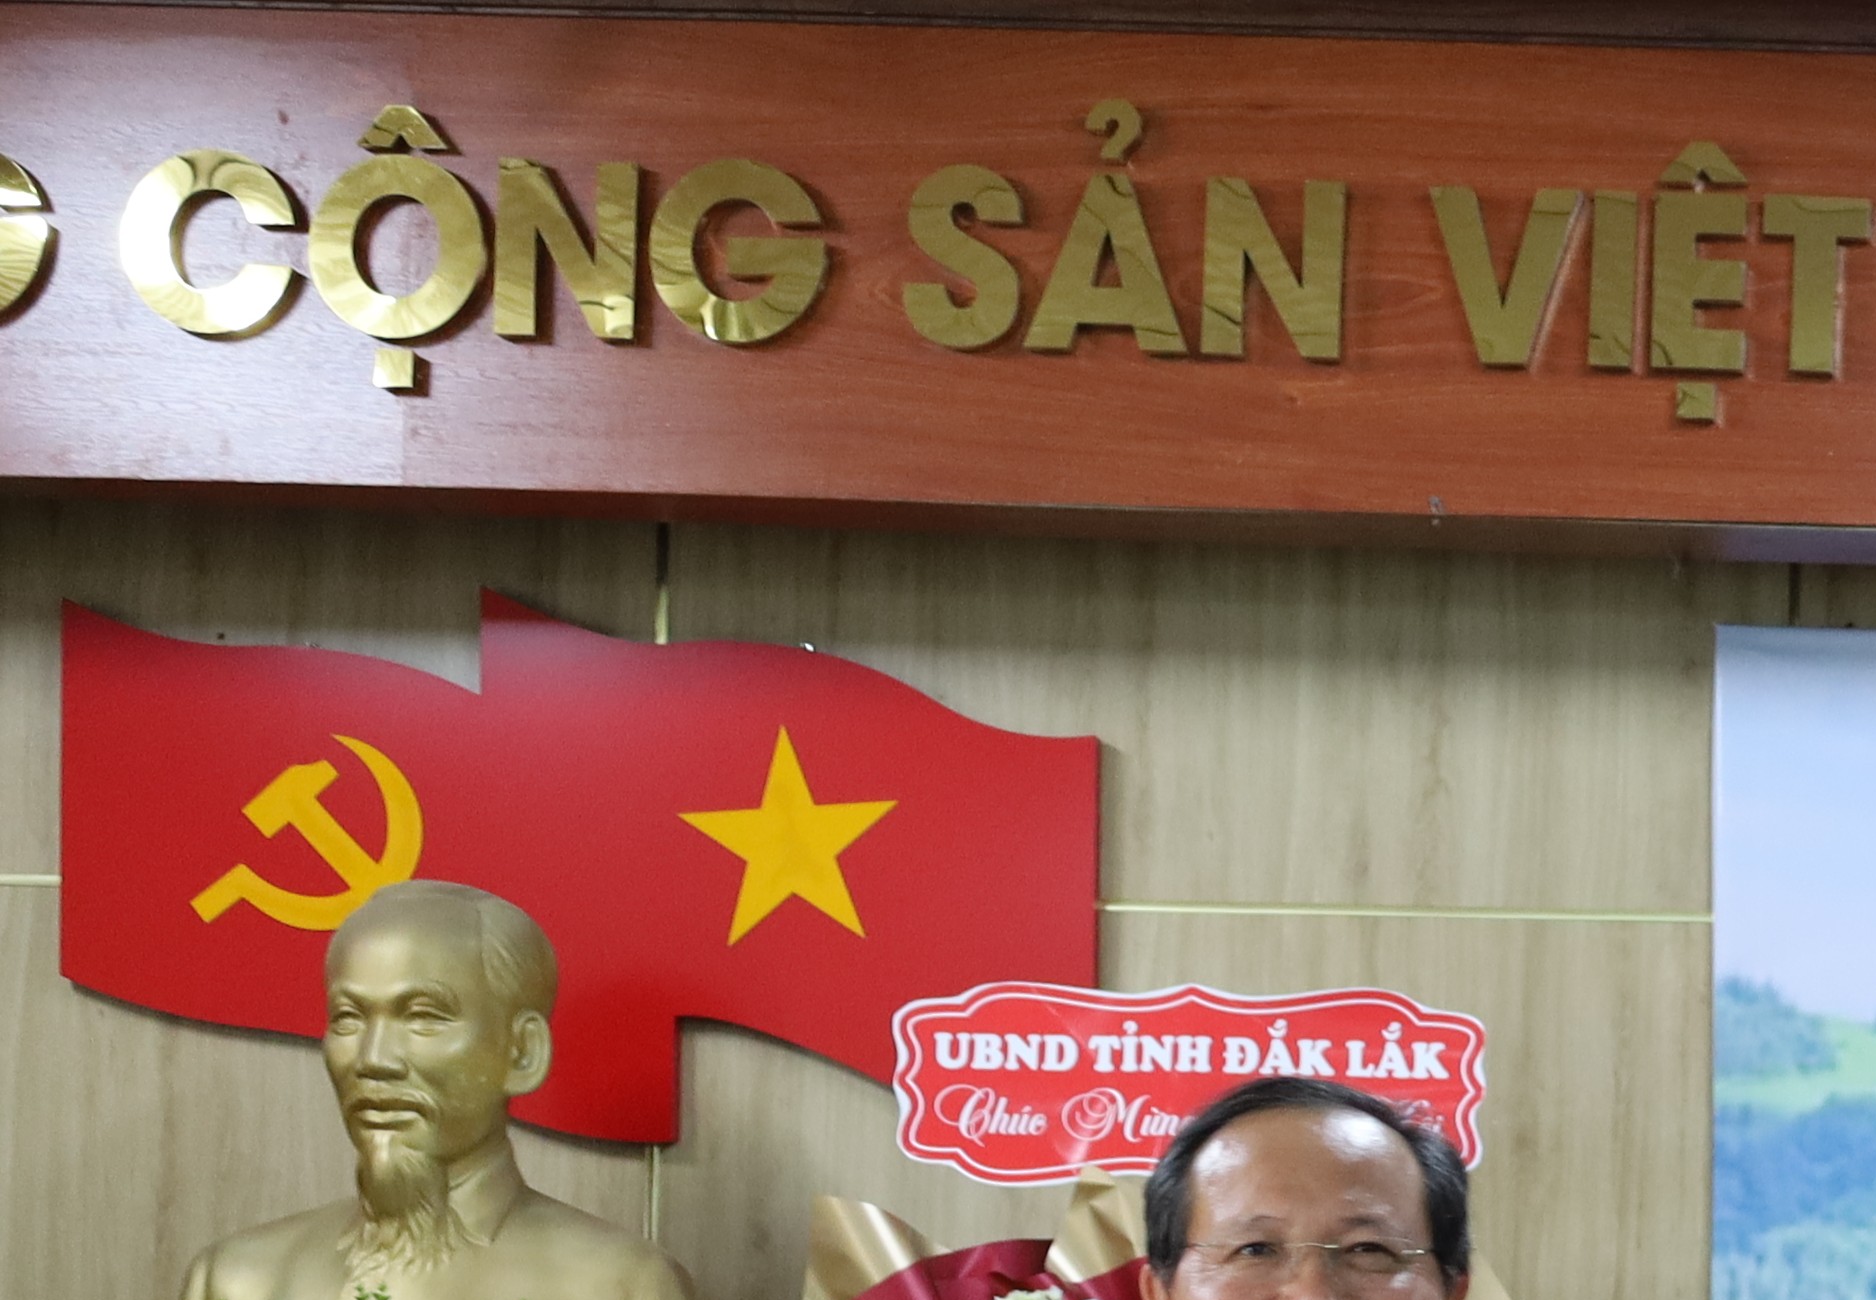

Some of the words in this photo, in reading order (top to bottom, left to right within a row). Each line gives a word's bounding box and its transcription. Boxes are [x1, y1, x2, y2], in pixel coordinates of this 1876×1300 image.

[119, 103, 829, 392] CỘNG
[901, 97, 1349, 365] SẢN
[1428, 139, 1876, 425] VIỆT
[934, 1031, 1080, 1071] UBND
[1089, 1020, 1213, 1075] TỈNH
[1222, 1019, 1333, 1077] ĐẮK
[1345, 1022, 1450, 1080] LẮK
[933, 1083, 1048, 1148] Chúc
